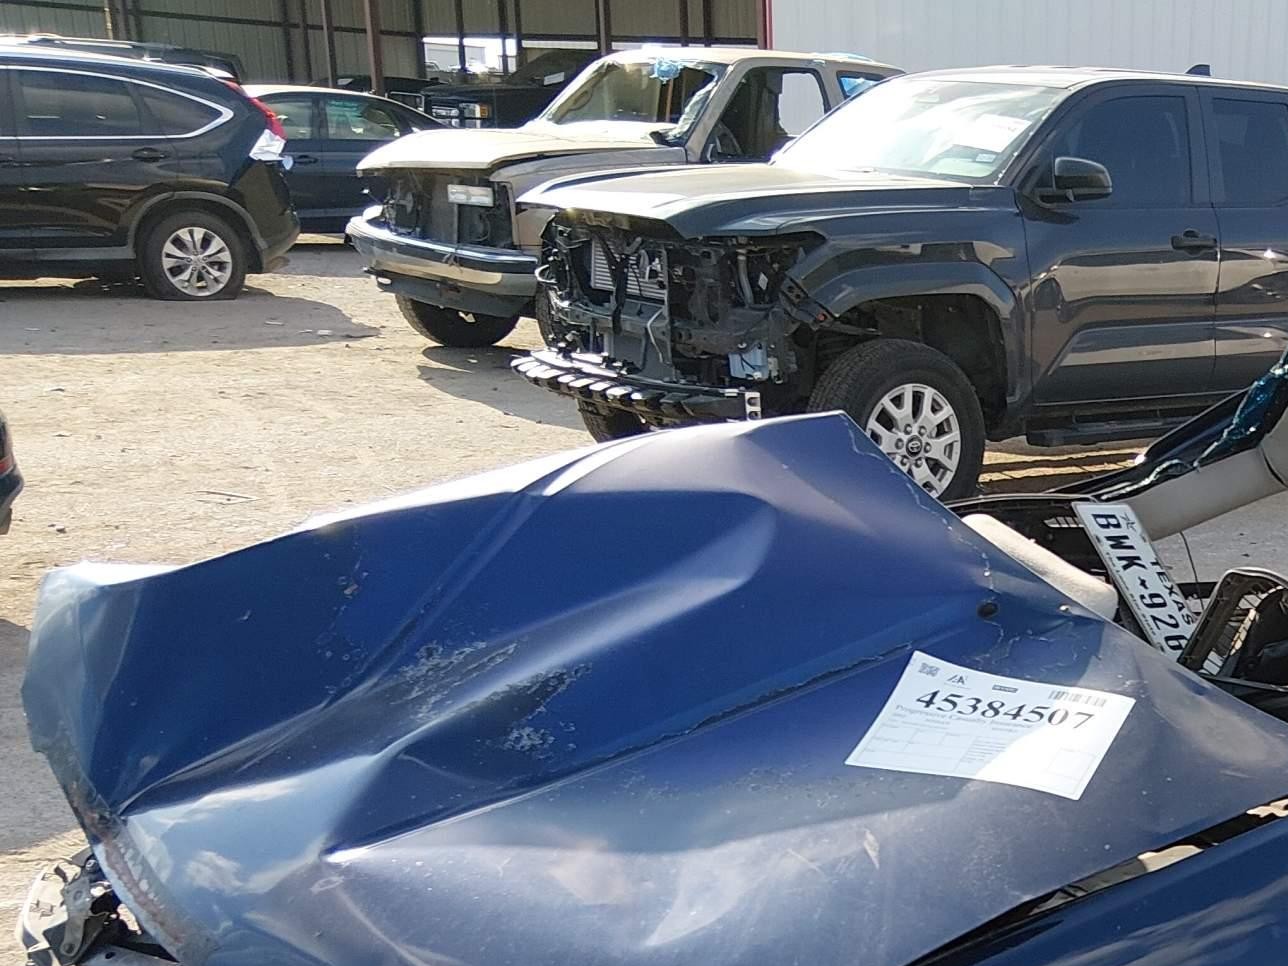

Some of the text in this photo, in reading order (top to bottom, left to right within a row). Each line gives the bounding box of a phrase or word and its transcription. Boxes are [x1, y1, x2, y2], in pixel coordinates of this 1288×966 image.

[1091, 513, 1188, 651] BWK-926
[1150, 557, 1194, 626] TEXAS
[916, 689, 1095, 729] 45384507
